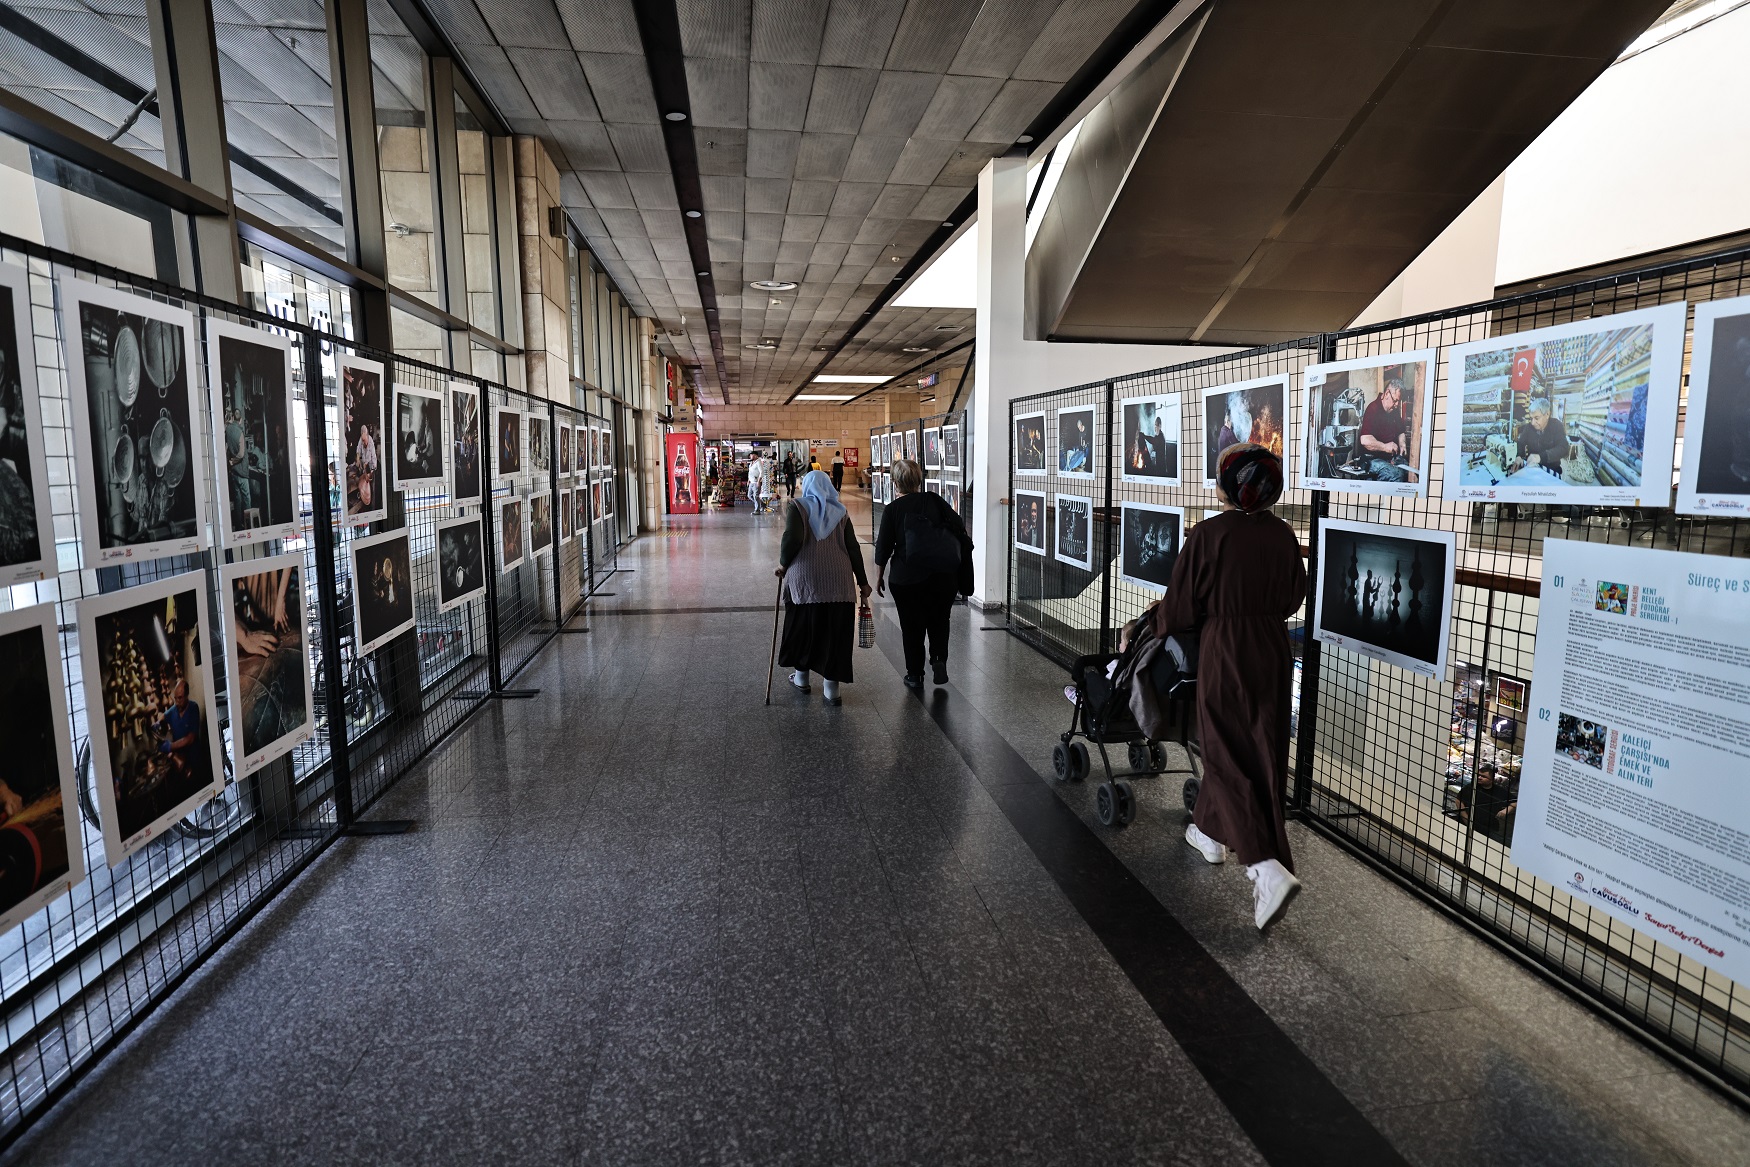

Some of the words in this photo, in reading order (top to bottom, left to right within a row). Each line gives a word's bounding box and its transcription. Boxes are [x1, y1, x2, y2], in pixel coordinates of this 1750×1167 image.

[1554, 575, 1564, 588] 01
[1688, 572, 1720, 592] Süreç
[1725, 579, 1738, 592] ve
[1642, 586, 1657, 596] KENT
[1640, 602, 1670, 615] FOTOĞRAF
[1539, 708, 1551, 722] 02
[1622, 733, 1652, 750] KALEİÇİ
[1620, 757, 1640, 772] EMEK
[1642, 766, 1650, 775] VE
[1618, 768, 1634, 781] ALIN
[1637, 774, 1653, 788] TERİ
